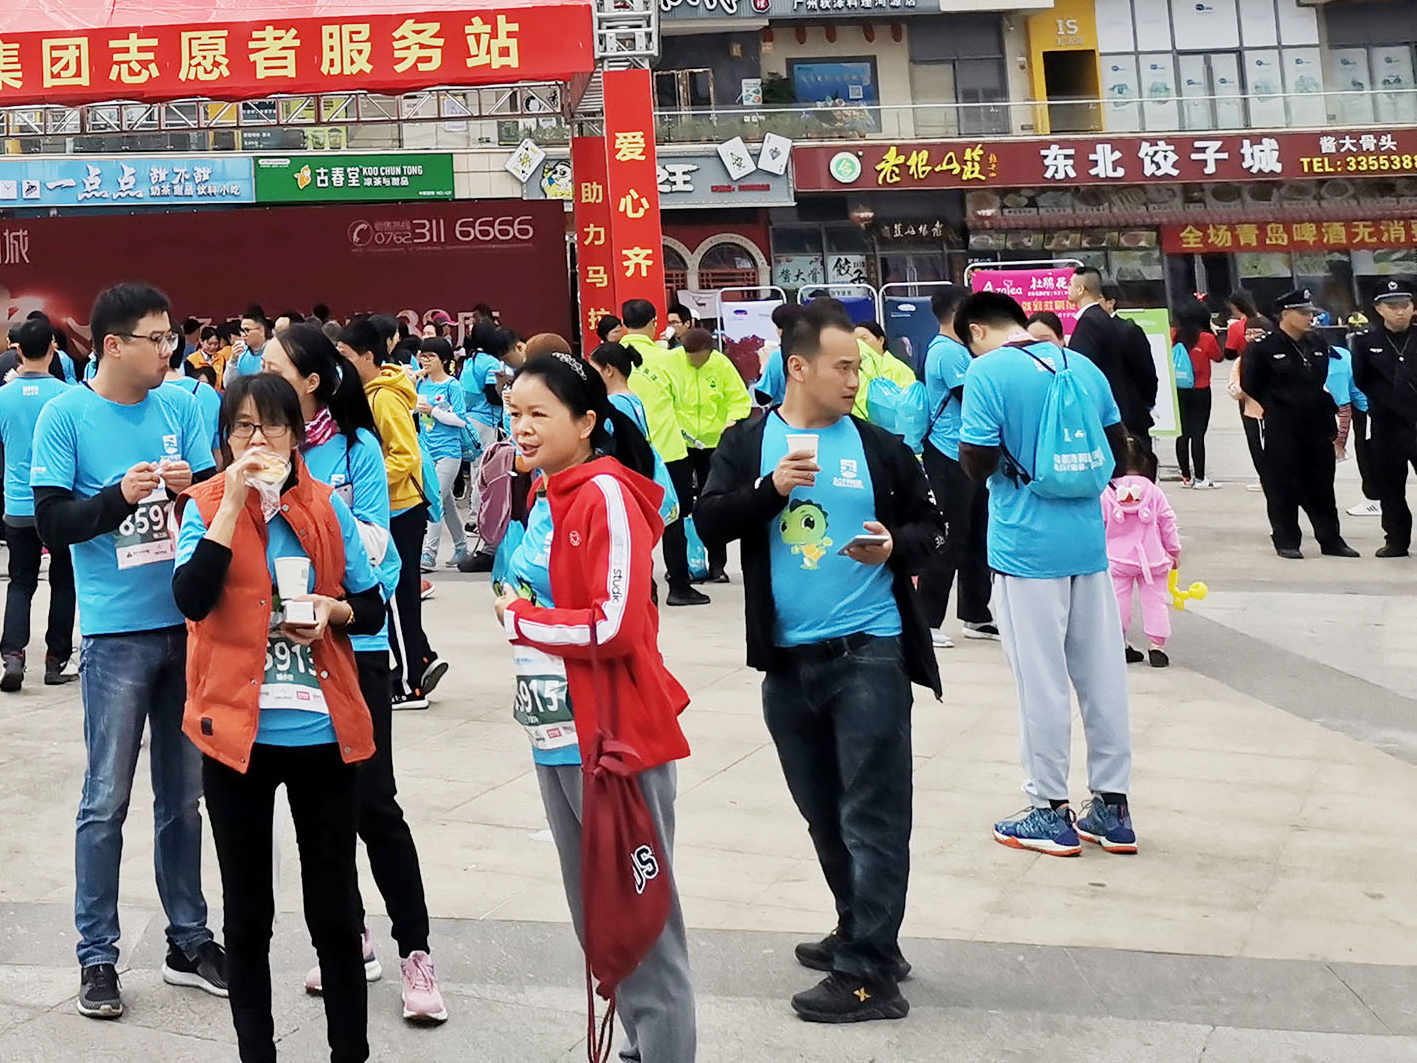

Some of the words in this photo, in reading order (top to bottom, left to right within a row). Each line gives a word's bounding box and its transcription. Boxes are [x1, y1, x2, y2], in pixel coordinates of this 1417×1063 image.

[1319, 134, 1398, 154] 酱大骨头
[1041, 137, 1283, 180] 东北饺子城
[315, 166, 361, 187] 古春堂
[363, 166, 379, 176] KOO
[381, 165, 402, 176] CHUN
[403, 165, 423, 175] TONG
[374, 231, 412, 244] 0762
[412, 219, 445, 243] 311
[455, 216, 534, 241] 6666
